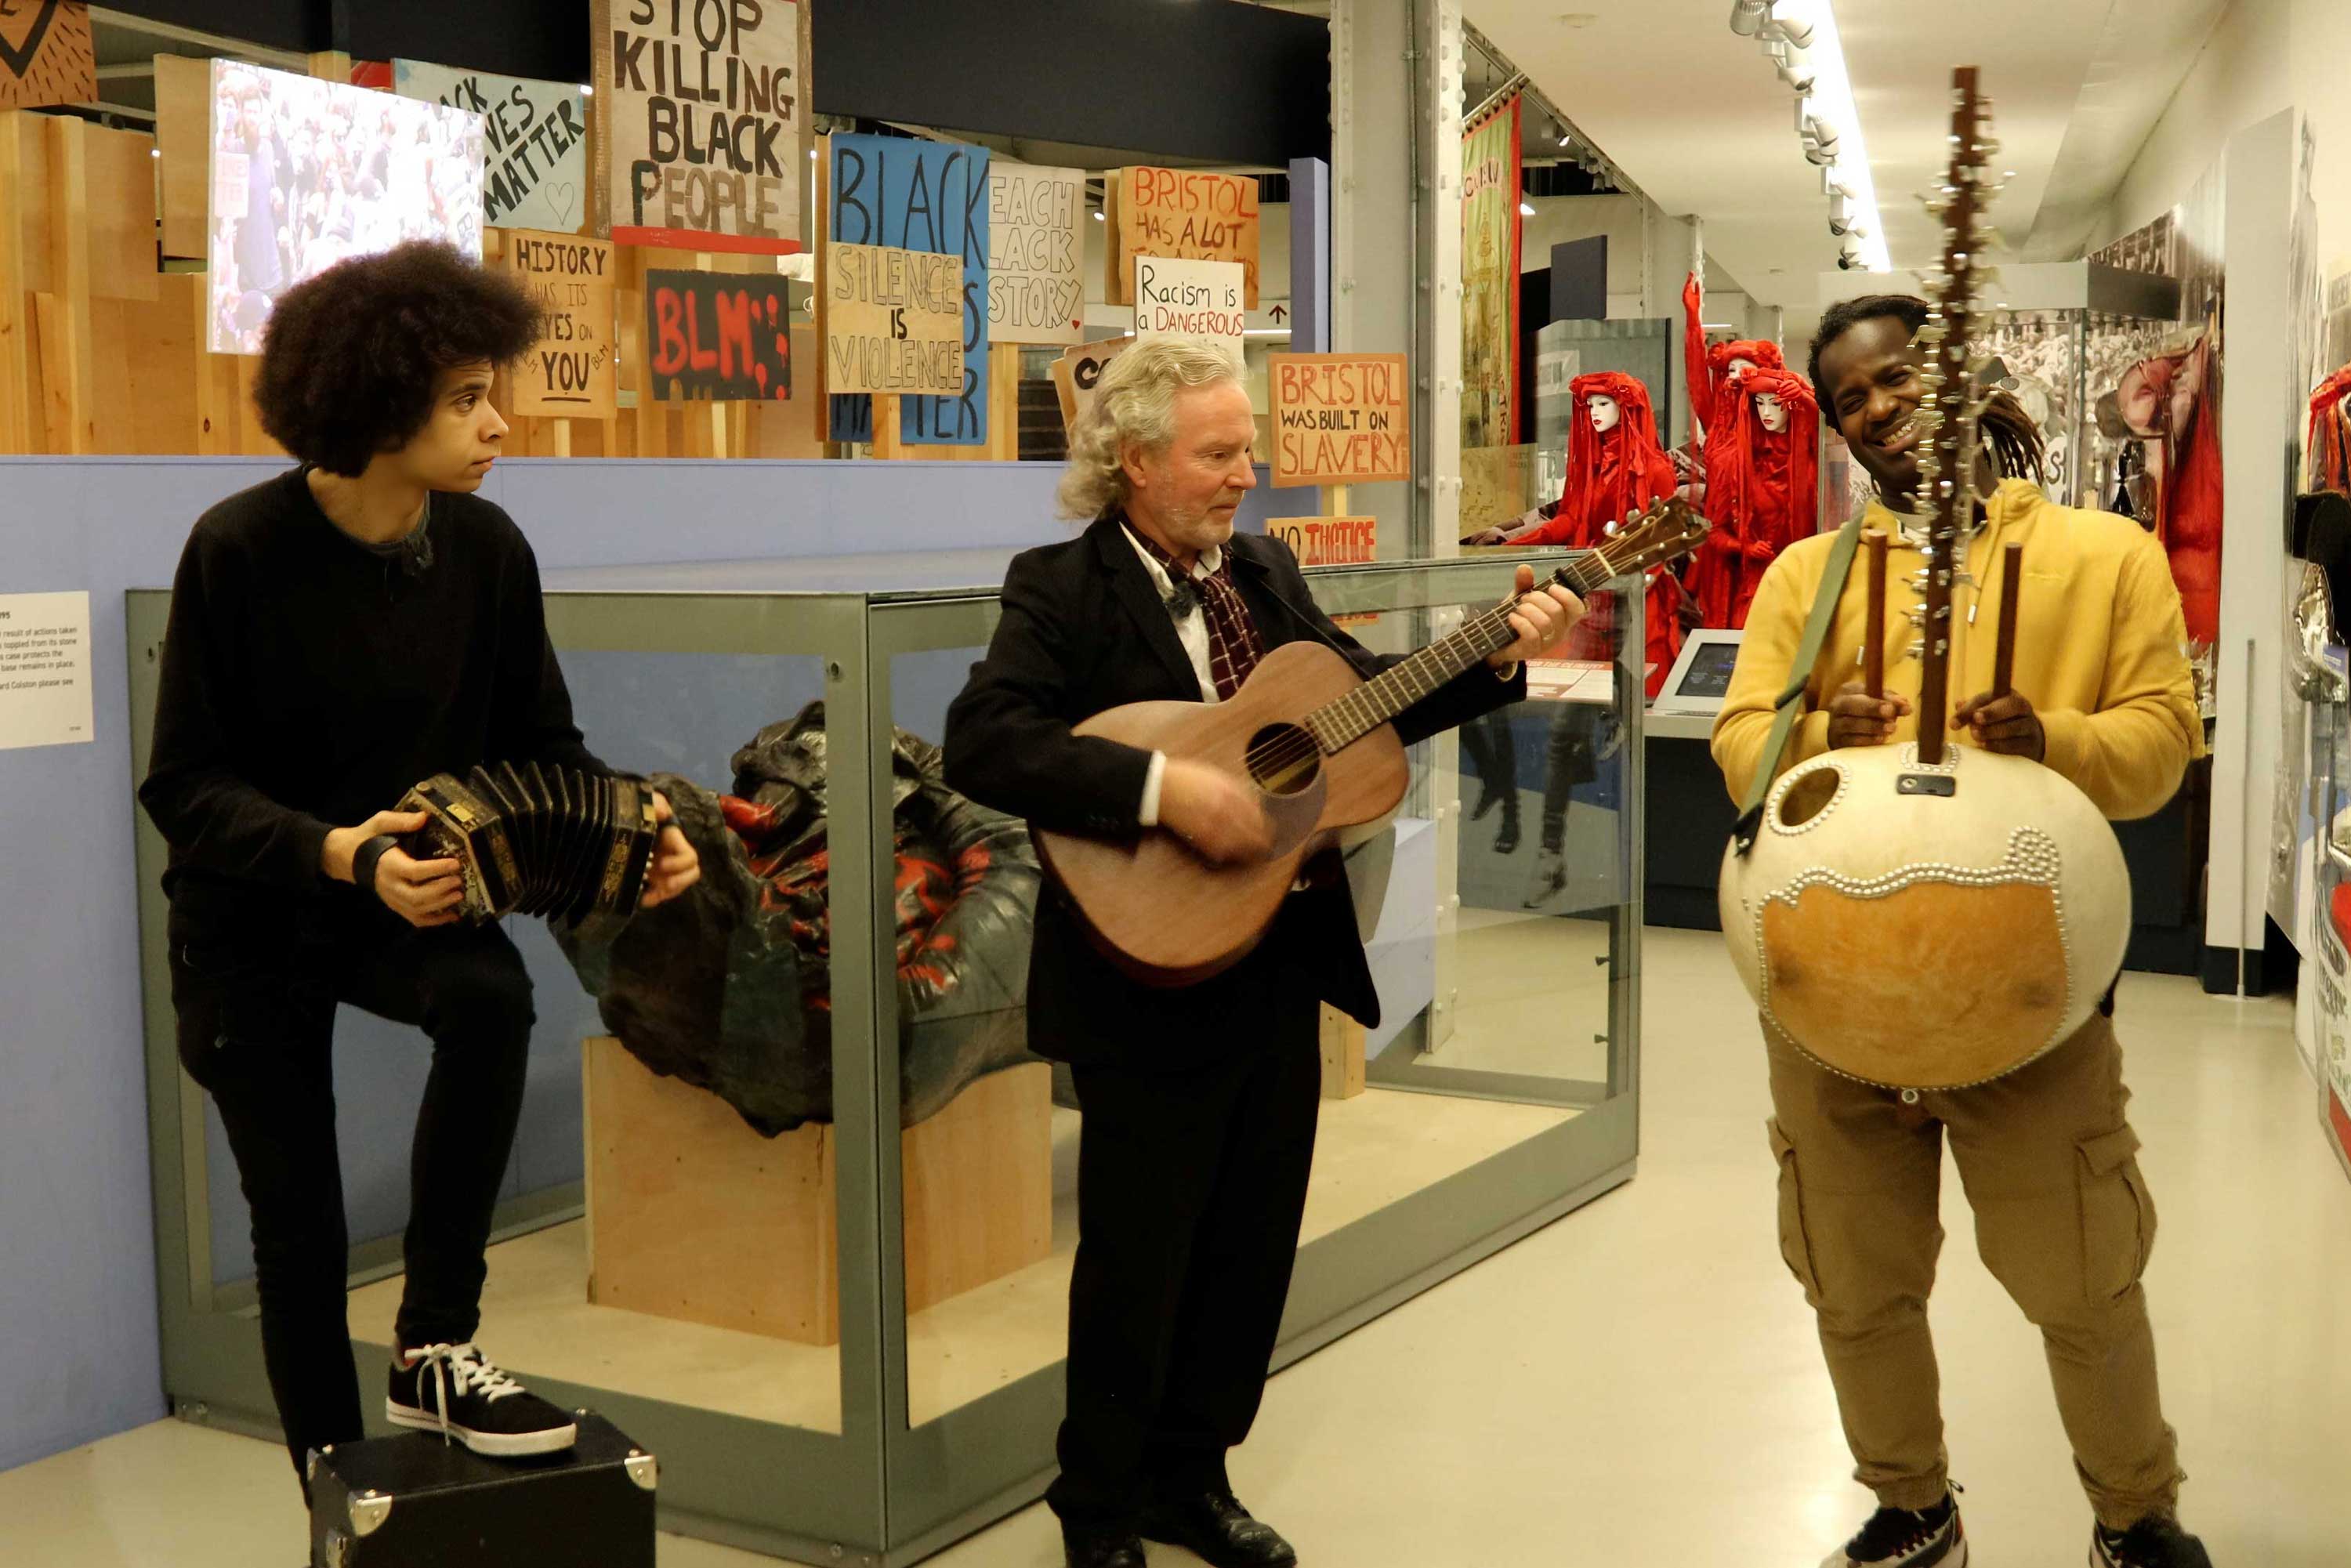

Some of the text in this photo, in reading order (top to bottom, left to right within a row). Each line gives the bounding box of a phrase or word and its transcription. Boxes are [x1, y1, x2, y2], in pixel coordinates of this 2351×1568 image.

[614, 30, 795, 121] KILLING
[485, 85, 534, 161] VES
[647, 96, 783, 179] BLACK
[484, 99, 585, 223] MATTER
[630, 159, 782, 239] PEOPLE
[836, 147, 990, 270] BLACK
[988, 176, 1074, 229] EACH
[1135, 167, 1258, 219] BRISTOL
[988, 226, 1075, 273] LACK
[1136, 211, 1173, 246] HAS
[516, 238, 607, 276] HISTORY
[567, 284, 588, 307] ITS
[835, 245, 958, 313] SILENCE
[1142, 265, 1211, 307] Racism
[1225, 284, 1237, 307] is
[987, 276, 1081, 328] STORY
[1138, 306, 1243, 336] a DANGEROUS
[543, 314, 592, 341] YES ON
[652, 287, 755, 381] BLM
[891, 308, 907, 339] IS
[541, 351, 589, 391] YOU
[590, 344, 609, 370] BLM
[831, 335, 962, 389] VIOLENCE
[1281, 363, 1401, 405] BRISTOL
[1281, 409, 1388, 430] WAS BUILT ON
[1281, 433, 1405, 475] SLAVERY
[23, 650, 50, 660] protects
[11, 680, 37, 689] Colston
[38, 679, 60, 688] please
